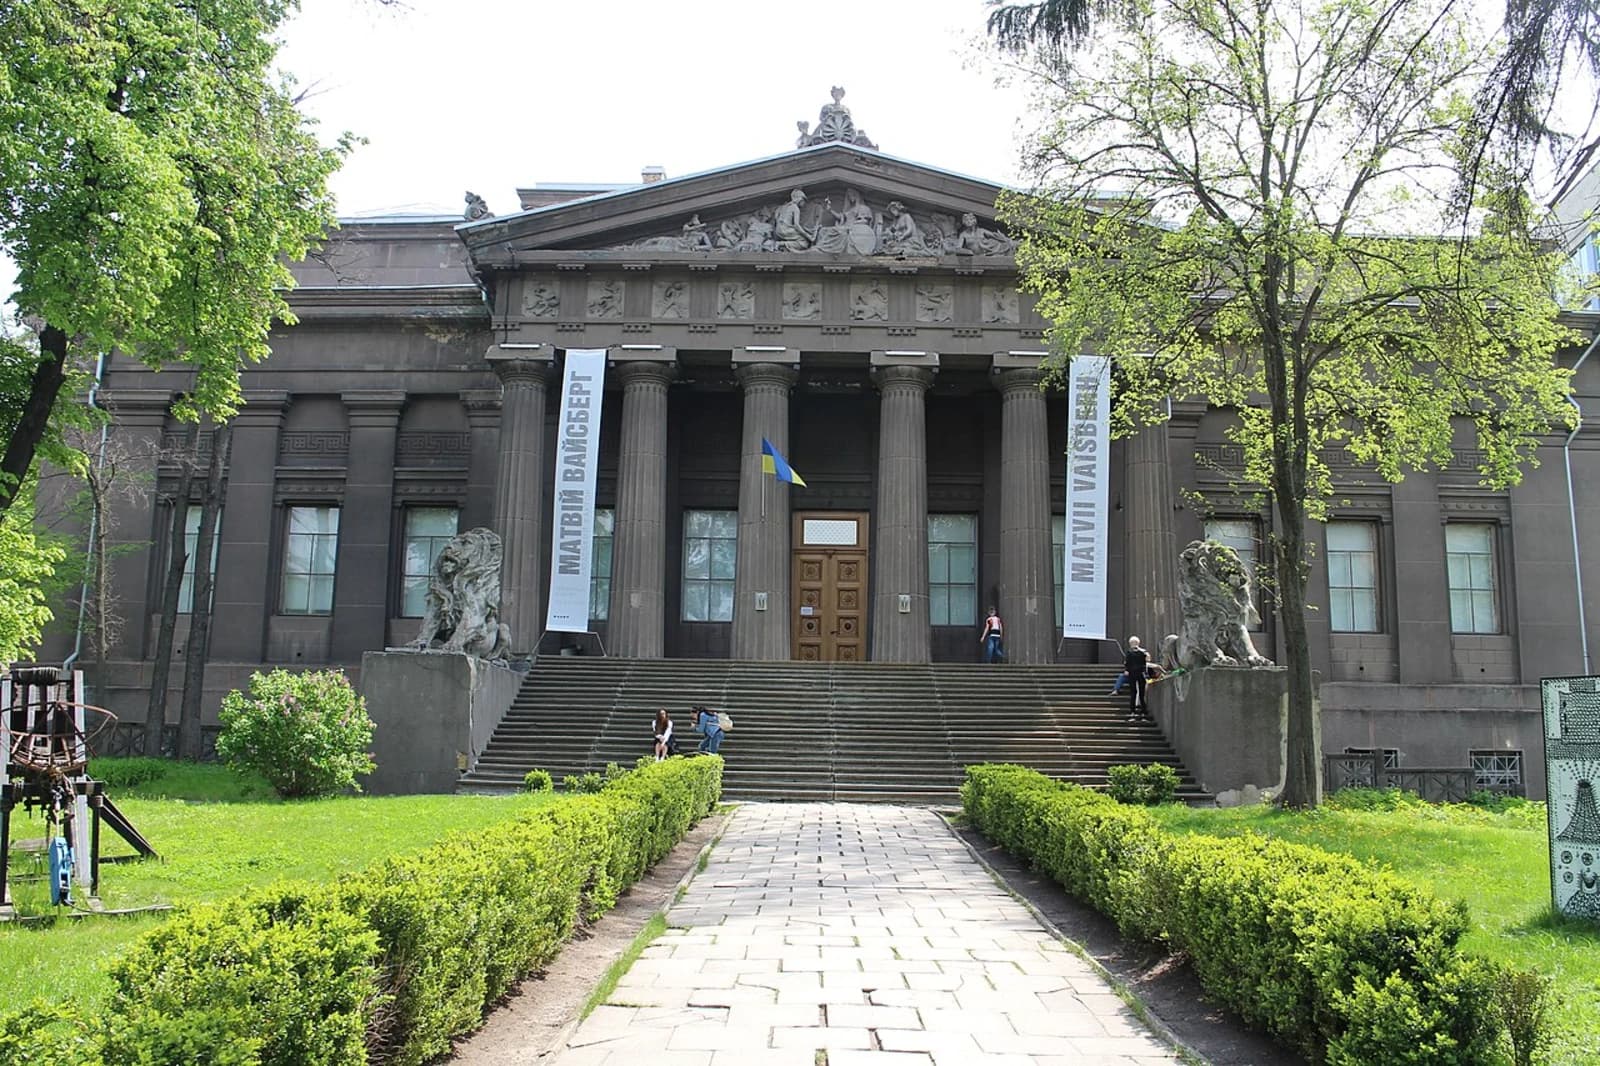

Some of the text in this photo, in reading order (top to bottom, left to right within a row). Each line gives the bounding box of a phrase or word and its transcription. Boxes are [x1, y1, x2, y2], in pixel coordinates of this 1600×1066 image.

[561, 371, 592, 482] ВАЙСБЕРГ
[558, 489, 584, 575] МАТВІЙ
[1071, 501, 1096, 582] MATVII
